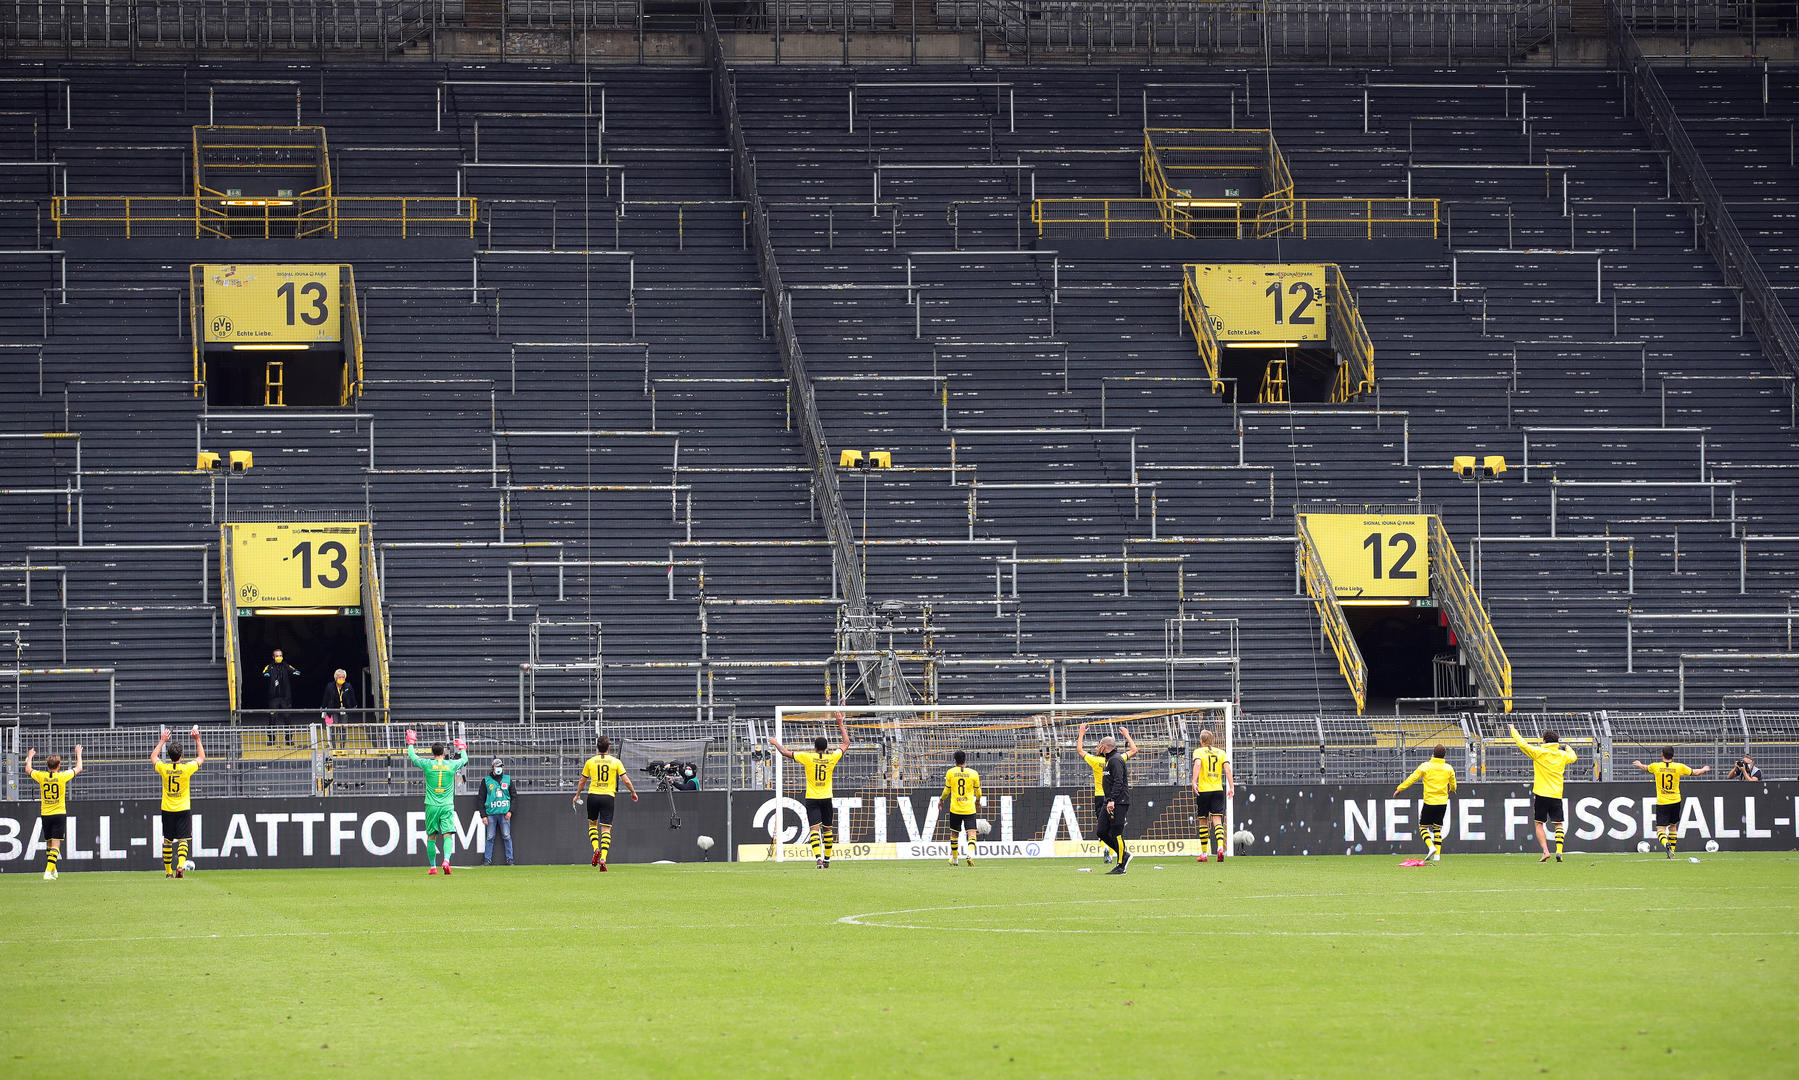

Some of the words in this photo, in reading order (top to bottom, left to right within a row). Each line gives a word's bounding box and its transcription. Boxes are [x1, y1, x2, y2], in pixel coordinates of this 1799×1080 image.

[277, 281, 329, 326] 13
[1266, 281, 1315, 325] 12
[213, 317, 232, 332] BVB
[292, 540, 348, 589] 13
[1363, 532, 1418, 580] 12
[242, 585, 258, 597] BVB
[1208, 754, 1218, 772] 17
[437, 770, 443, 788] 1
[597, 764, 610, 782] 18
[814, 763, 827, 782] 16
[168, 774, 181, 793] 15
[957, 778, 966, 796] 8
[1661, 773, 1674, 791] 13
[43, 783, 60, 800] 29
[490, 800, 510, 808] HOST
[911, 844, 967, 857] SIGNL
[974, 843, 1023, 856] IDUNA
